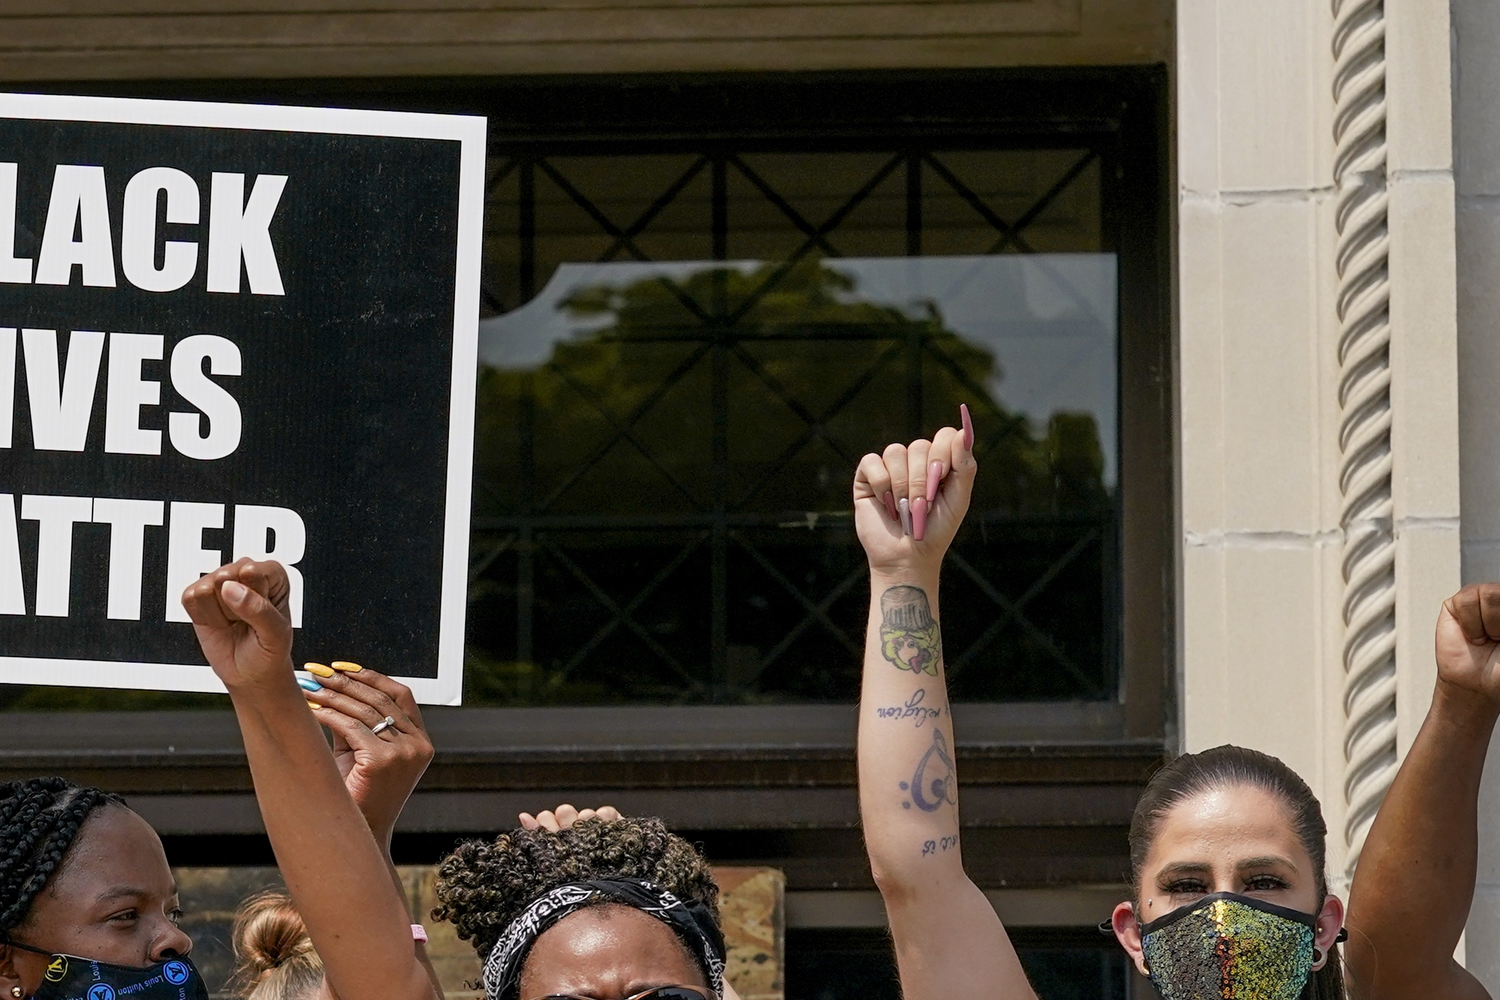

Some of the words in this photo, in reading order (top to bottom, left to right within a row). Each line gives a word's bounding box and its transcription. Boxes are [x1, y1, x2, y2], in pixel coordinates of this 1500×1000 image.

[877, 688, 941, 728] religion
[145, 974, 164, 989] Louis
[117, 983, 145, 996] Vuitton
